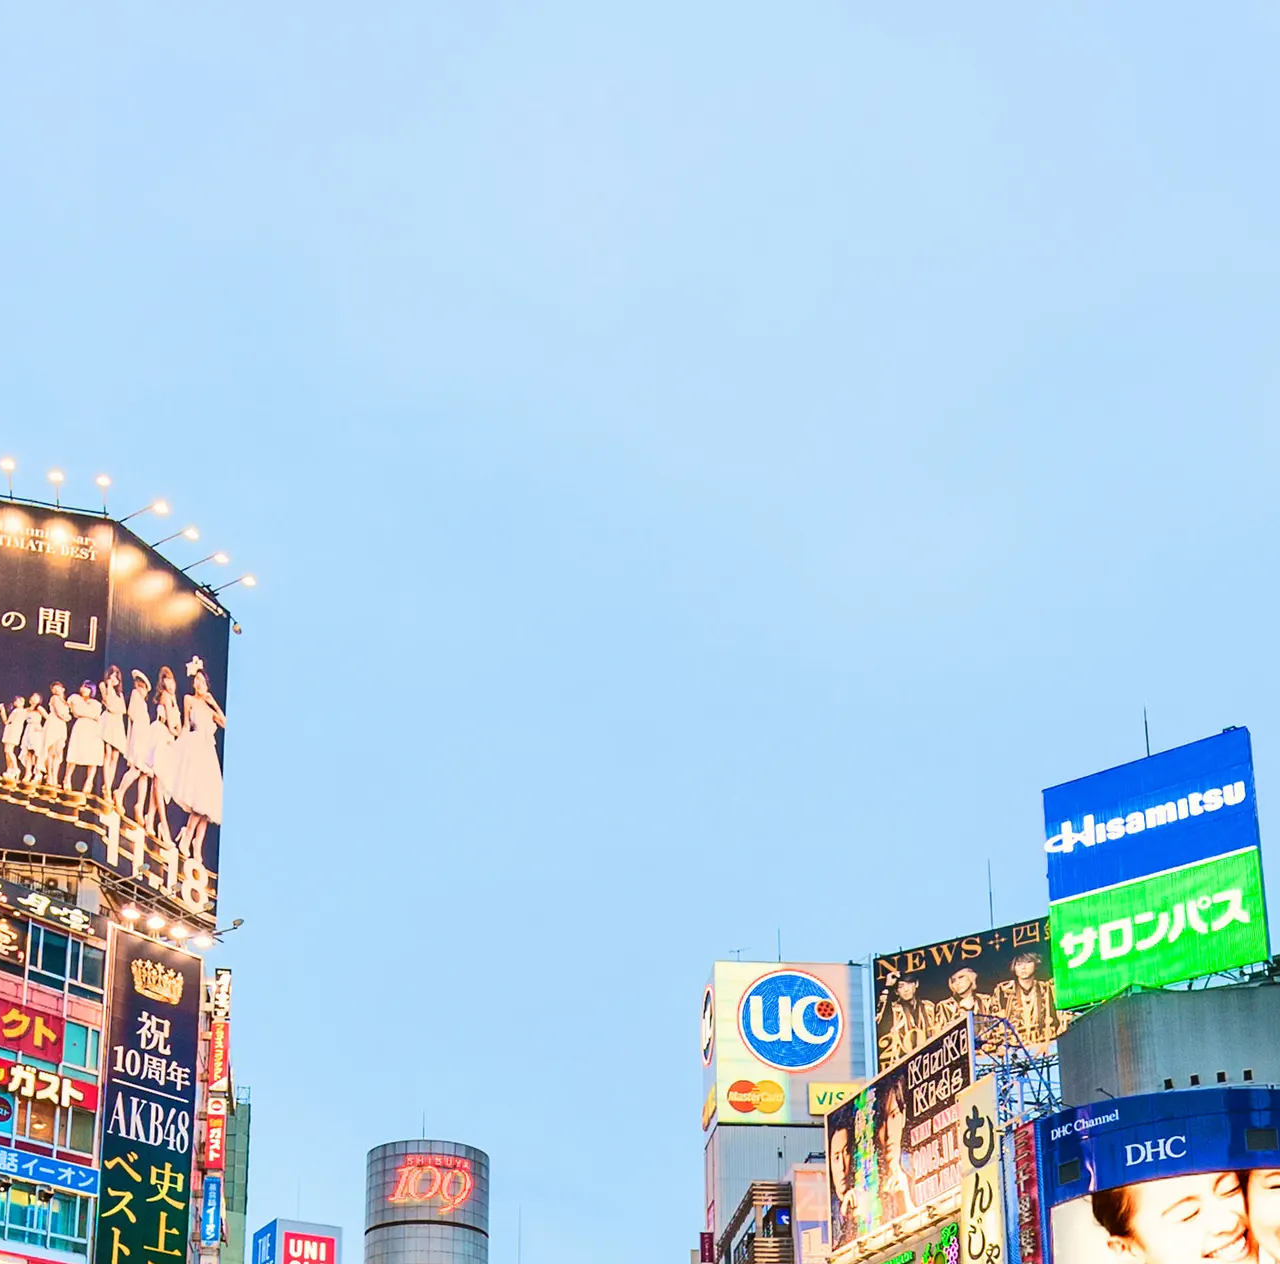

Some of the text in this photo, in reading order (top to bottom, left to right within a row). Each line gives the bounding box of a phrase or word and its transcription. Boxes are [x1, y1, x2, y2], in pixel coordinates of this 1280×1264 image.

[61, 543, 98, 561] BEST
[1044, 781, 1247, 853] Hisamitsu
[1060, 888, 1250, 968] サロンパス
[877, 937, 982, 980] NEWS
[136, 1011, 172, 1056] 祝
[8, 1065, 84, 1108] ガスト
[112, 1045, 192, 1092] 10周年
[728, 1091, 784, 1103] MasterCard
[107, 1091, 189, 1154] AKB48
[1051, 1110, 1120, 1141] DHC Channel
[404, 1154, 471, 1169] SHIBUYA
[1125, 1136, 1187, 1166] DHC
[388, 1165, 474, 1216] 109
[289, 1239, 327, 1260] UNI
